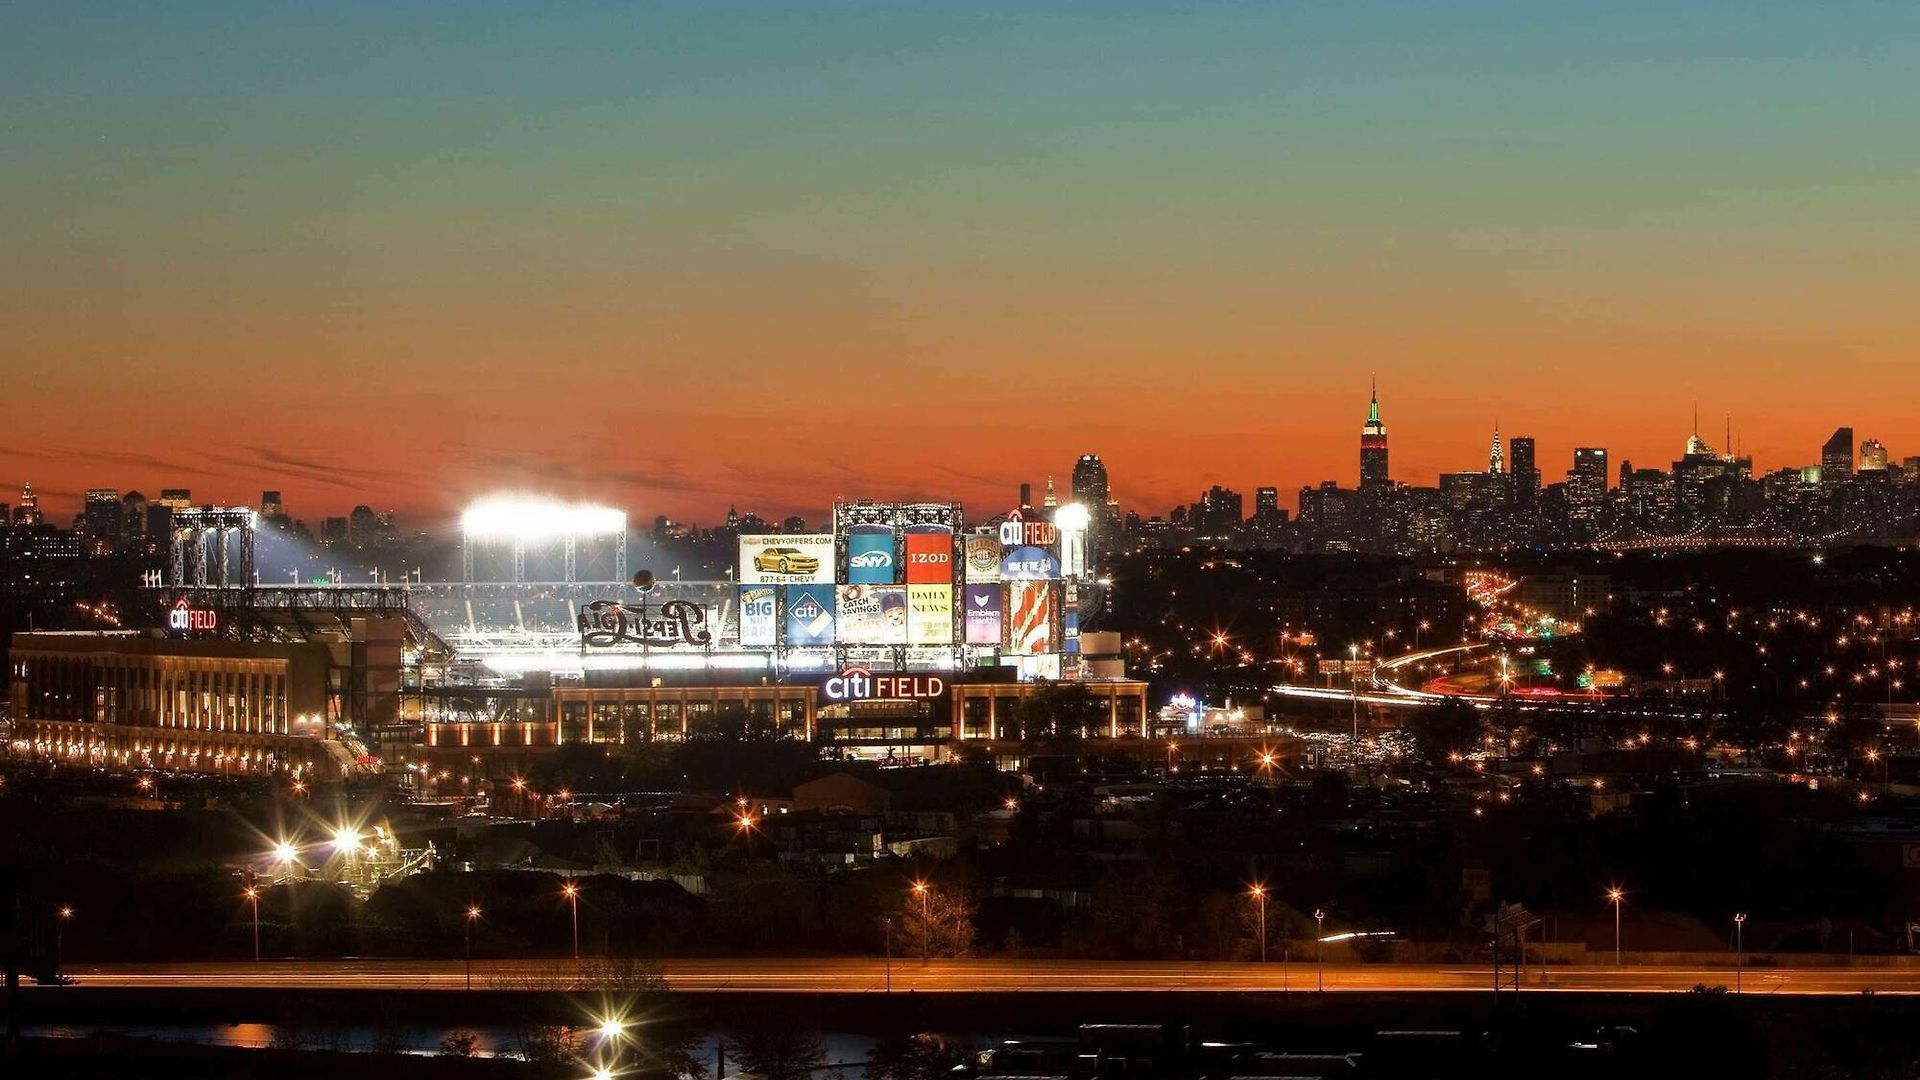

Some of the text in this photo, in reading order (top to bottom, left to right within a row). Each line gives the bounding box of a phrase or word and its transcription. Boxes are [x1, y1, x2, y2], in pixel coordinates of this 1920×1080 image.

[1024, 522, 1056, 545] FIELD
[850, 554, 889, 568] SNY
[912, 554, 948, 563] IZOD
[912, 592, 947, 600] DAILY
[745, 602, 773, 616] BIG
[843, 597, 869, 609] CATCH
[912, 604, 949, 612] NEWS
[795, 603, 818, 618] citi
[842, 604, 880, 616] SAVINGS!
[967, 609, 1000, 617] Emblem
[189, 610, 216, 629] FIELD
[825, 672, 943, 699] citi FIELD
